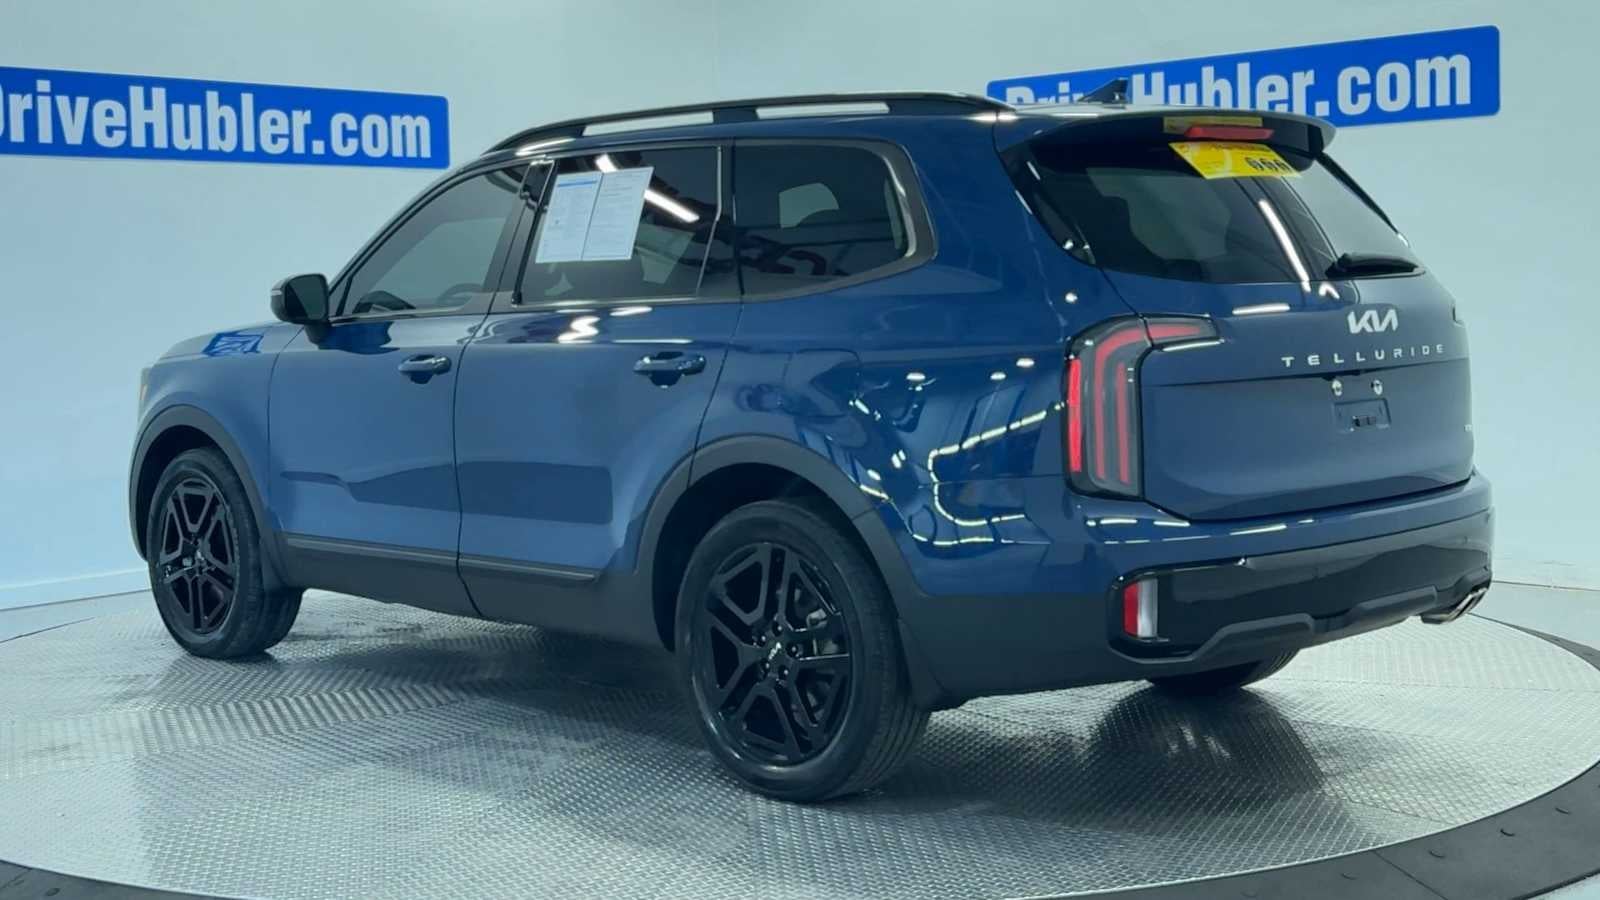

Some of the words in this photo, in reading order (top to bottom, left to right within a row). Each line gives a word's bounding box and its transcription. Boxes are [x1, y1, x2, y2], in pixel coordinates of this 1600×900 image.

[1006, 54, 1471, 117] Hubler.com
[0, 79, 431, 158] riveHubler.com
[1347, 309, 1398, 334] KIA
[1281, 344, 1444, 367] TELLURIDE
